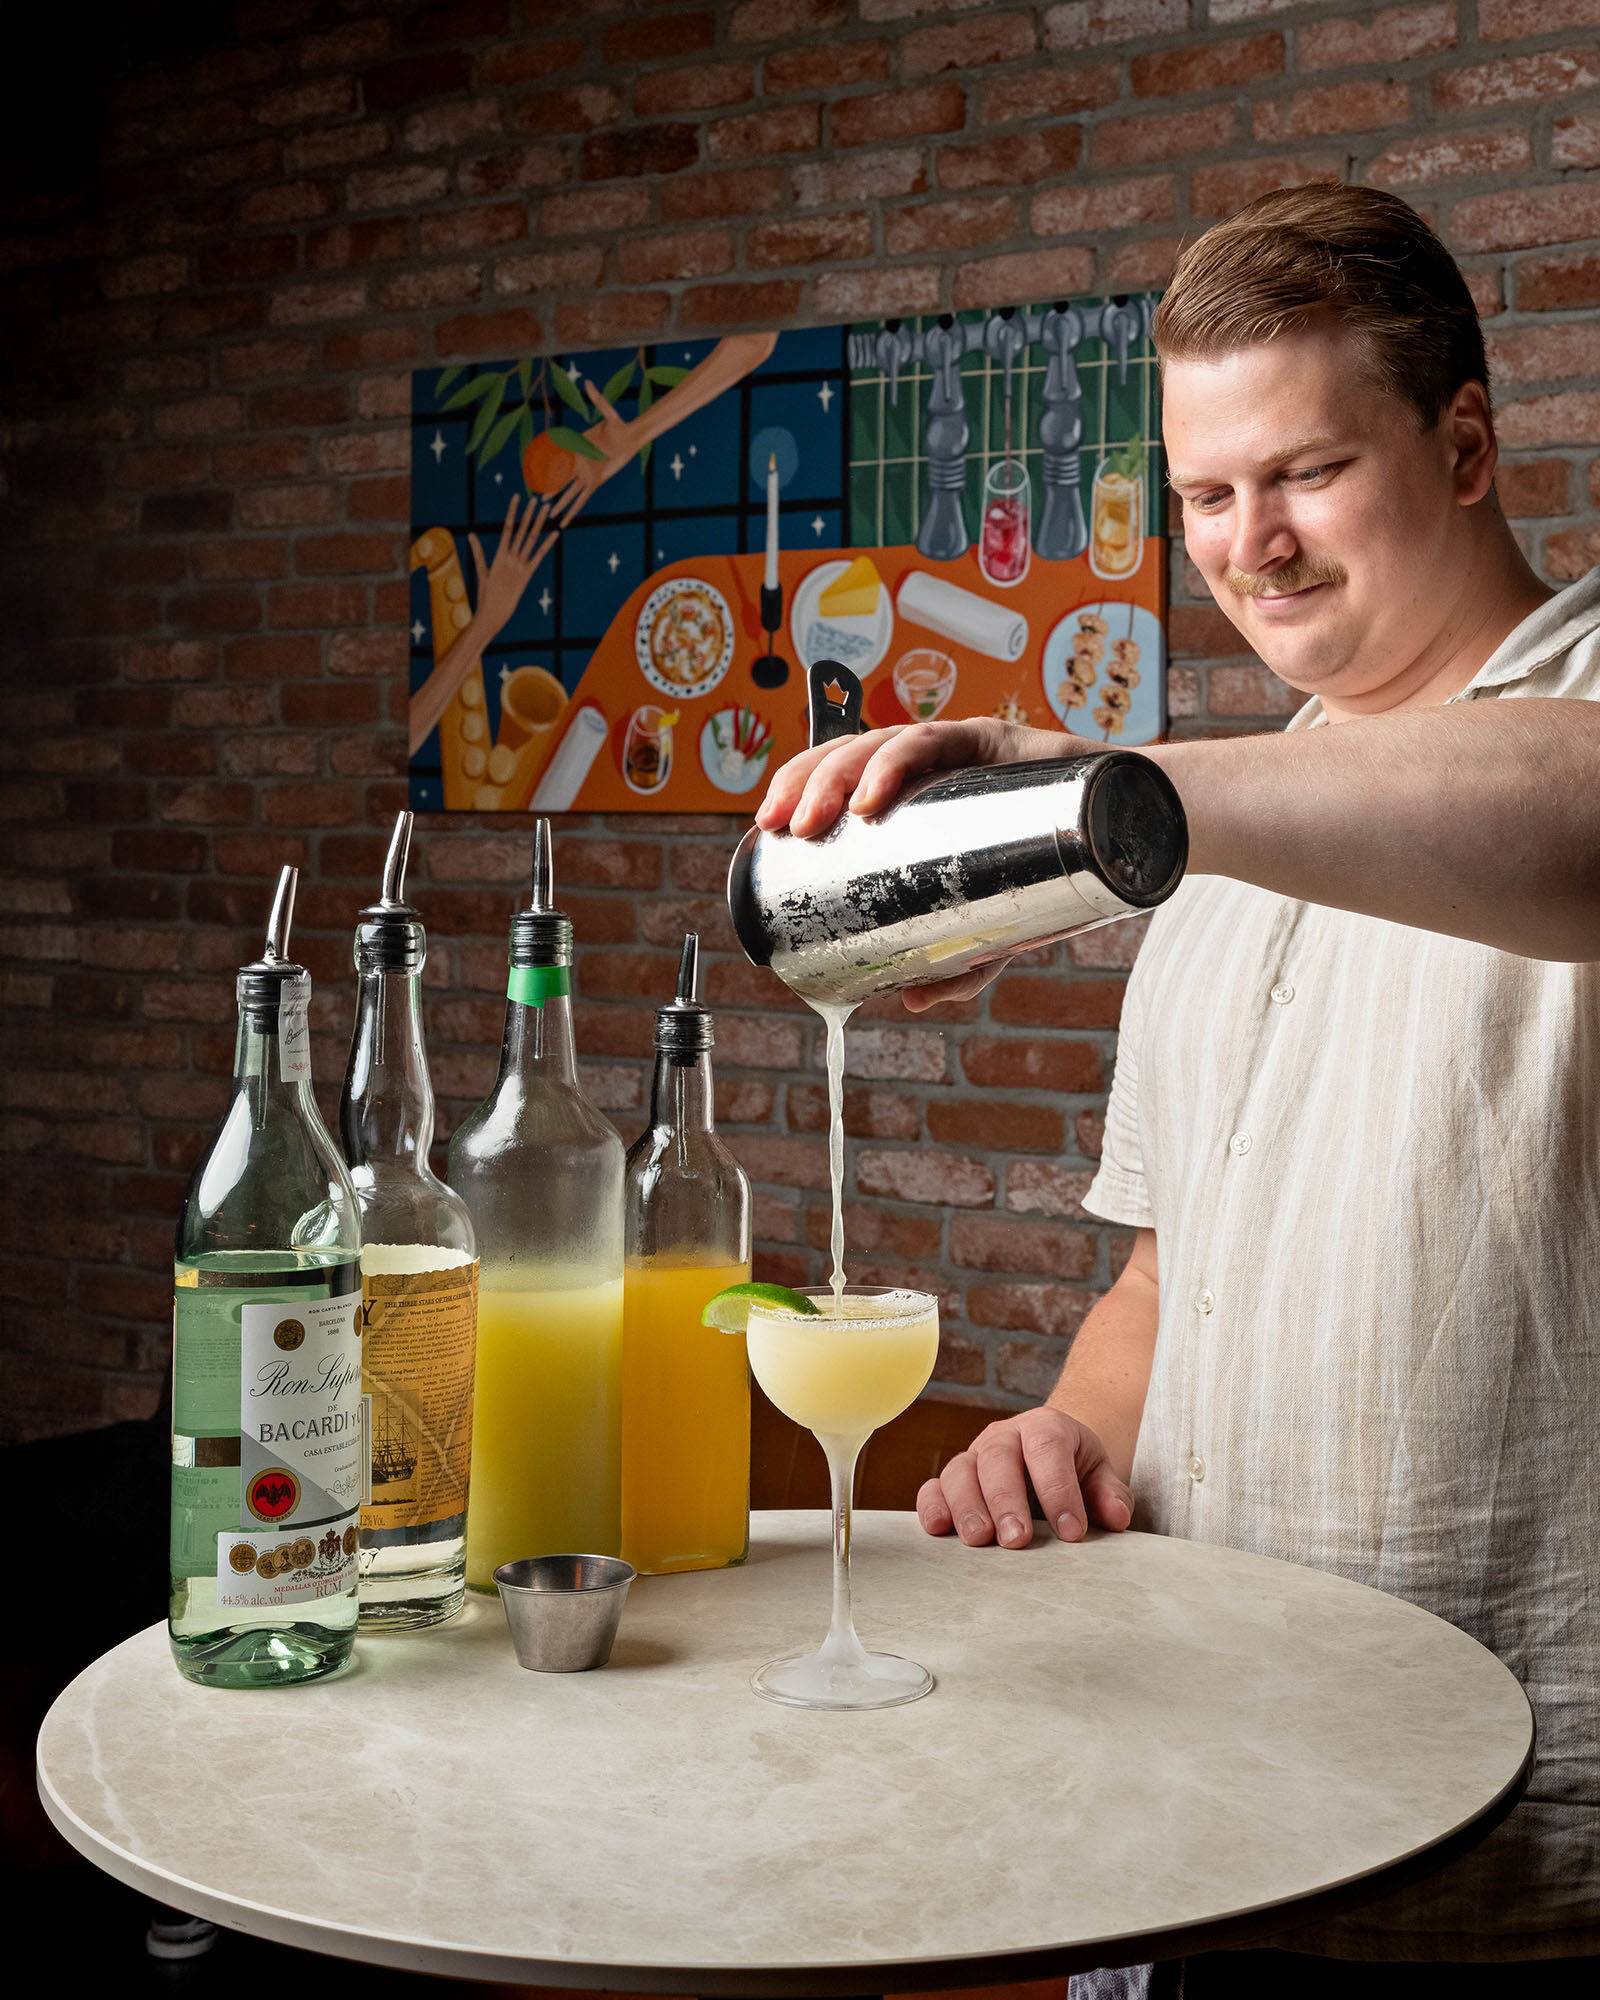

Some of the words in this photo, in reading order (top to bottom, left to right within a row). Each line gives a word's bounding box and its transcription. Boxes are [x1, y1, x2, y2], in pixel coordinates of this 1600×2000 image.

[398, 1300, 417, 1308] THREE
[419, 1298, 435, 1306] STARS
[319, 1316, 346, 1327] BARCELONA
[250, 1360, 309, 1397] Ron
[327, 1404, 339, 1413] DE
[259, 1411, 348, 1444] BACARDI
[303, 1444, 323, 1458] CASA
[274, 1581, 311, 1593] MEDALLAS
[316, 1580, 342, 1597] RUM
[221, 1594, 249, 1606] 44.5%
[250, 1593, 267, 1606] alc.
[267, 1592, 286, 1605] vol.
